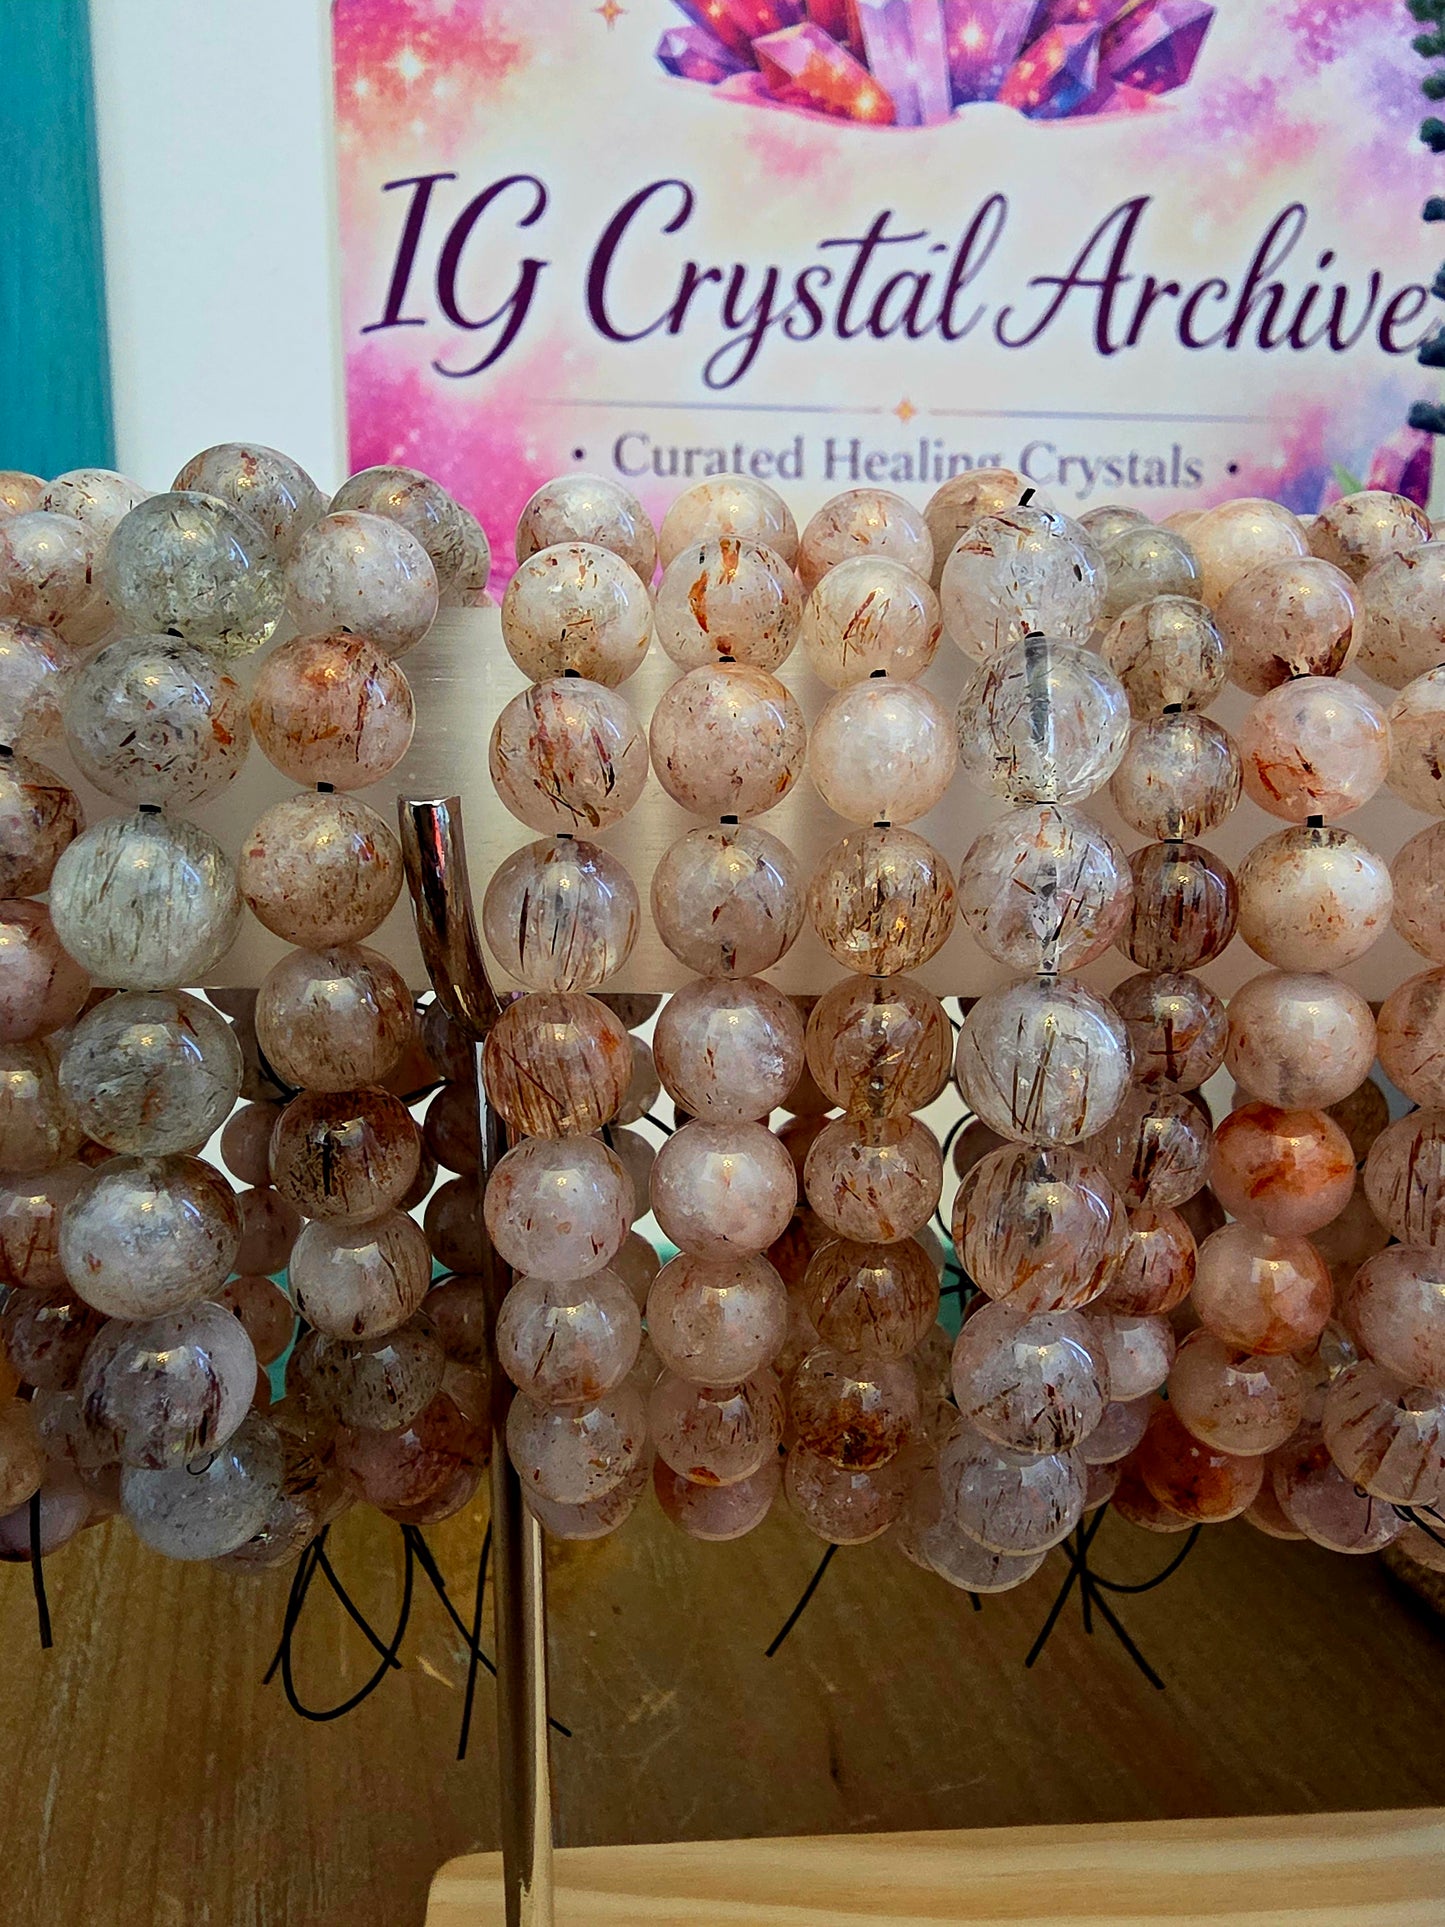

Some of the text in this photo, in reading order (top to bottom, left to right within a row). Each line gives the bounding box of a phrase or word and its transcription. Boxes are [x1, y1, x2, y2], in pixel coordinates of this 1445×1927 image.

[362, 172, 1440, 390] IG Crystal Archive
[612, 430, 805, 479] Curated
[1018, 440, 1204, 500] Crystals
